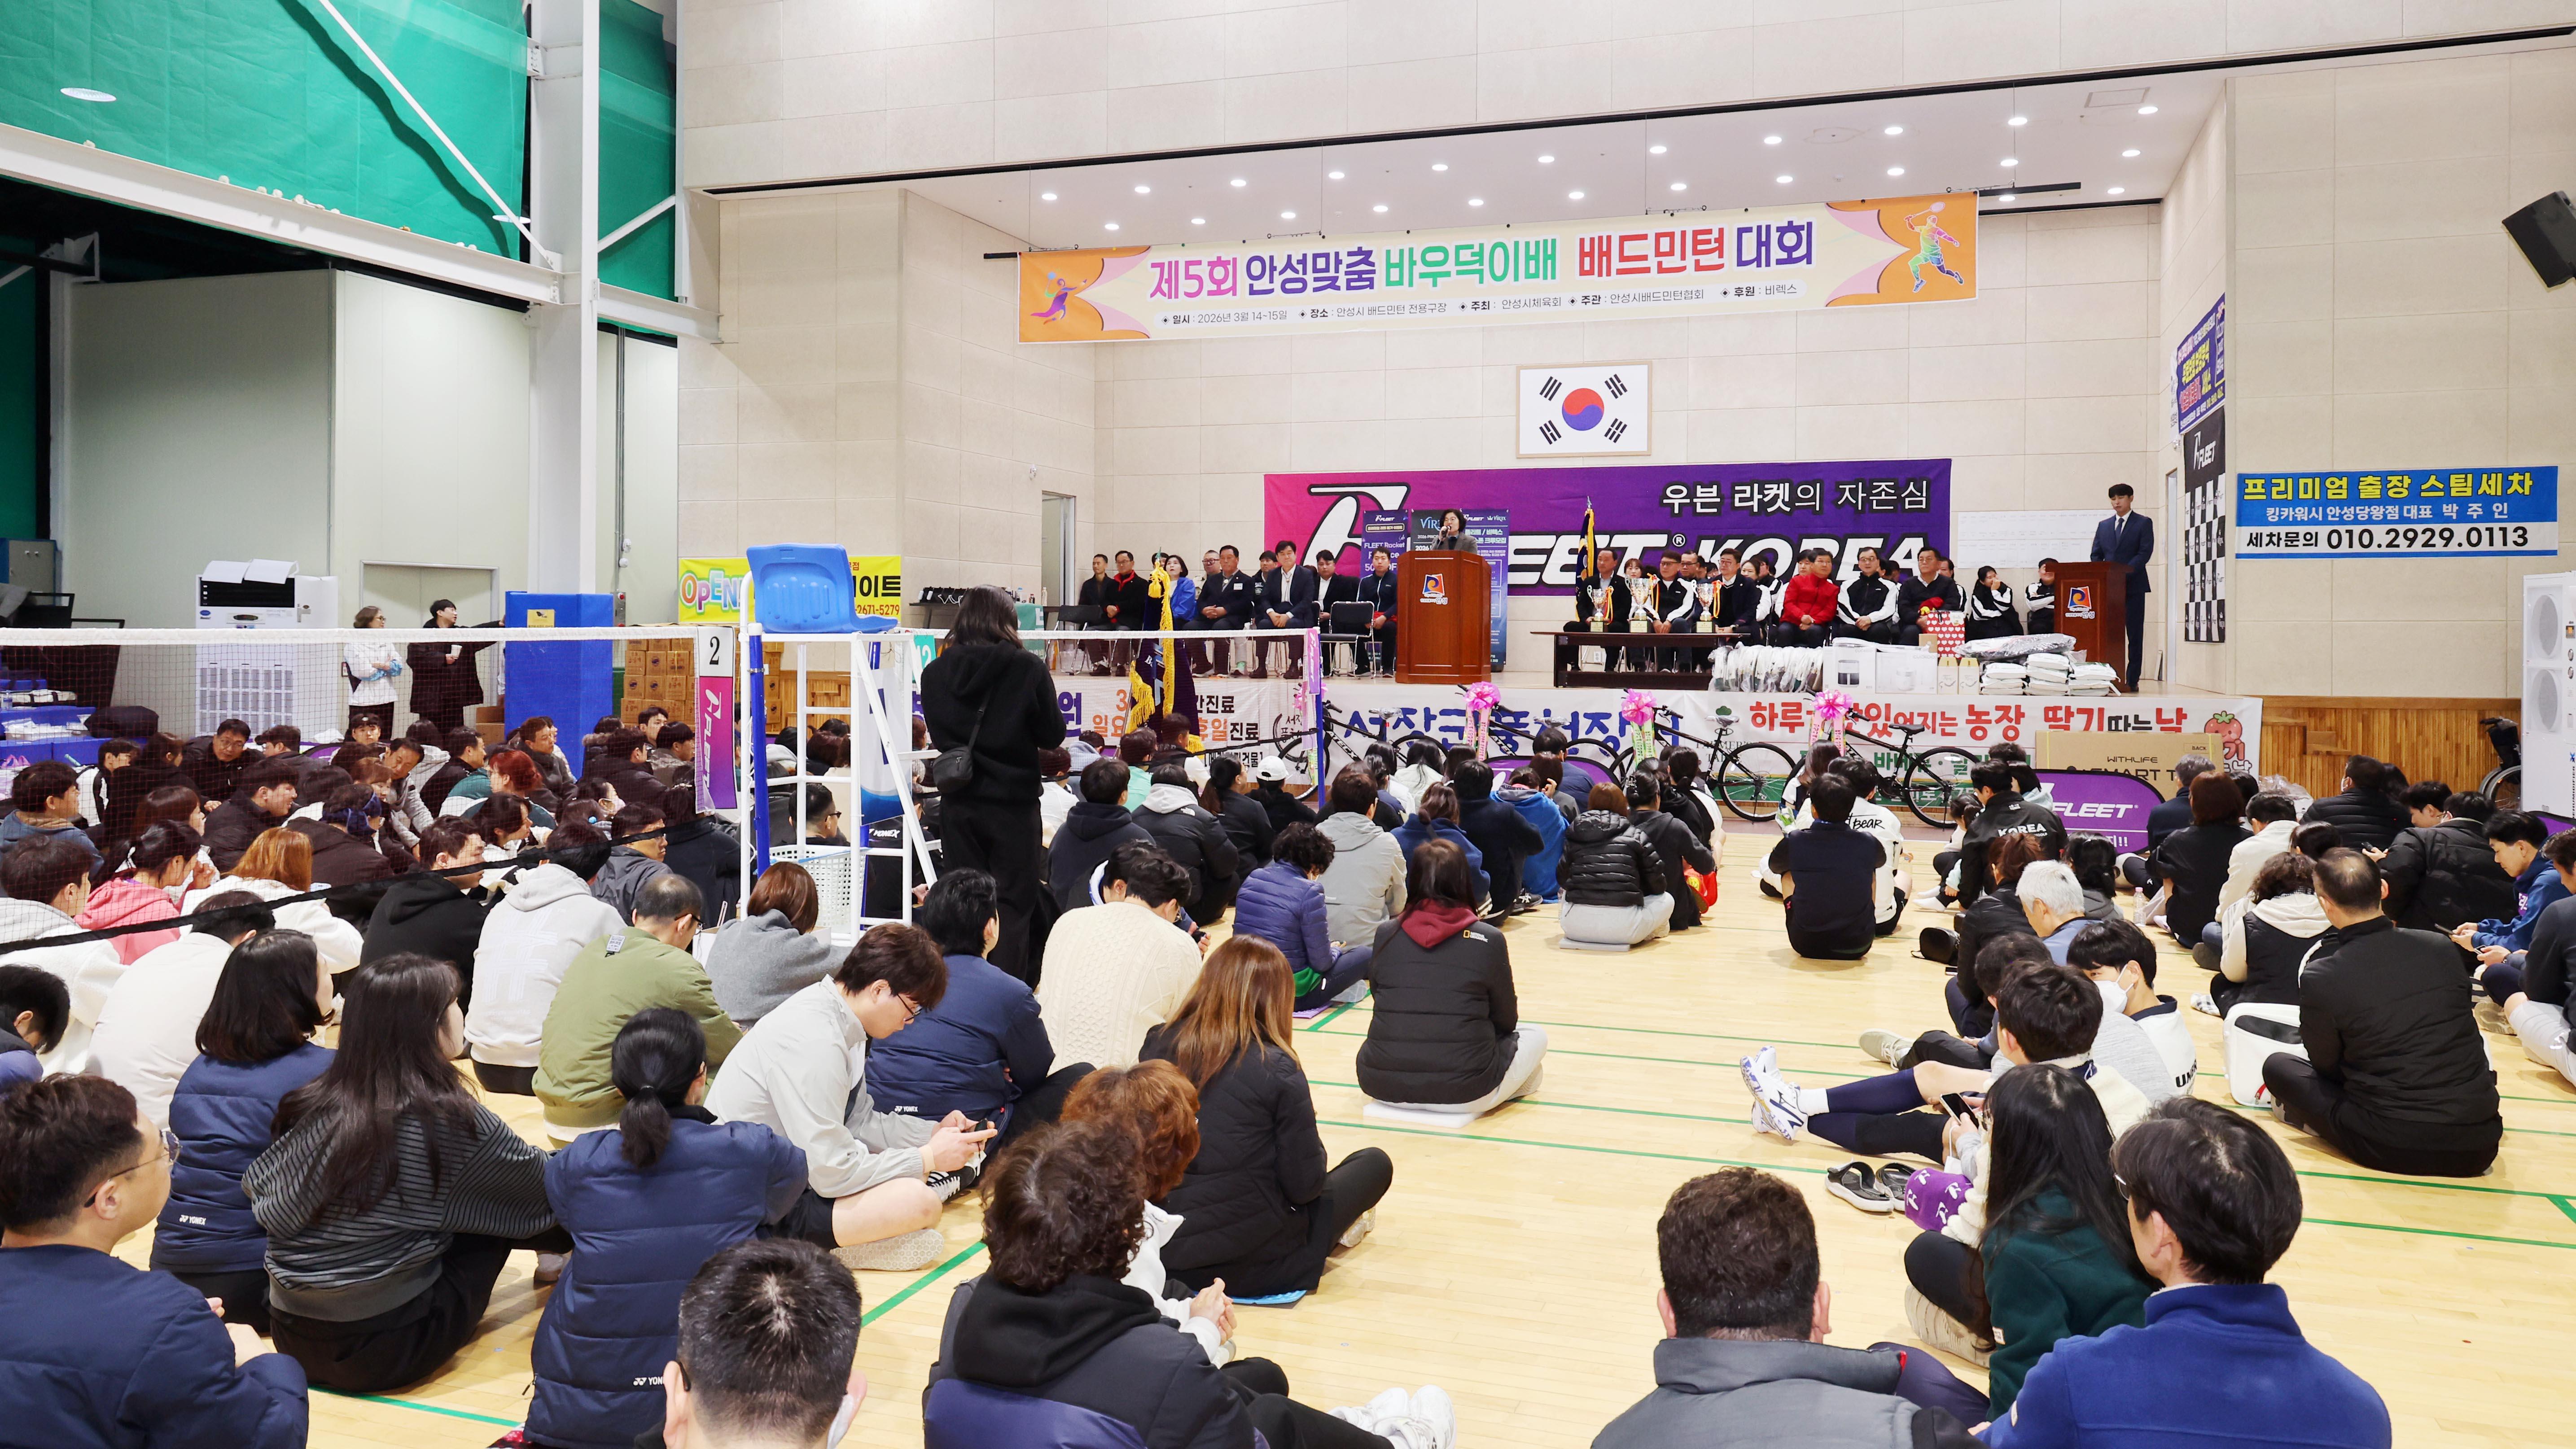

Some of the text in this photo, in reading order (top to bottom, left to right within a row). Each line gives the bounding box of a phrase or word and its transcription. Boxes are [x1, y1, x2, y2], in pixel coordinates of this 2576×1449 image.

[1150, 220, 1814, 300] 제5회 안성맞춤 바우덕이배 배드민턴 대회
[1173, 315, 1190, 324] 일시
[1198, 313, 1231, 323] 2026년
[1234, 312, 1249, 322] 3월
[1252, 310, 1287, 321] 14~15일
[1310, 308, 1328, 318] 장소
[1337, 306, 1364, 317] 안성시
[1368, 305, 1405, 315] 배드민턴
[1409, 303, 1447, 313] 전용구장
[1471, 301, 1490, 311] 주최
[1502, 297, 1561, 309] 안성시체육회
[1581, 295, 1601, 305] 주관
[1610, 289, 1704, 304] 안성시배드민턴협회
[1734, 287, 1755, 298] 후원
[1765, 284, 1797, 295] 비렉스
[1662, 480, 1928, 513] 우븐 라켓의 자존심
[2244, 472, 2532, 501] 프리미엄 출장 스팀세차
[2266, 507, 2322, 521] 킹카워시
[2326, 506, 2399, 521] 안성당왕점
[2403, 504, 2432, 519] 대표
[2246, 531, 2318, 547] 세차문의
[2327, 526, 2528, 549] 010.2929.0113
[853, 575, 901, 597] 이트
[709, 636, 720, 665] 2
[1750, 701, 1813, 733] 하루
[1966, 704, 2025, 741] 농장
[703, 713, 713, 789] FLEET
[873, 829, 900, 838] YONEX
[1998, 823, 2047, 837] KOREA
[189, 1216, 207, 1226] YONEX
[648, 1376, 663, 1385] YON
